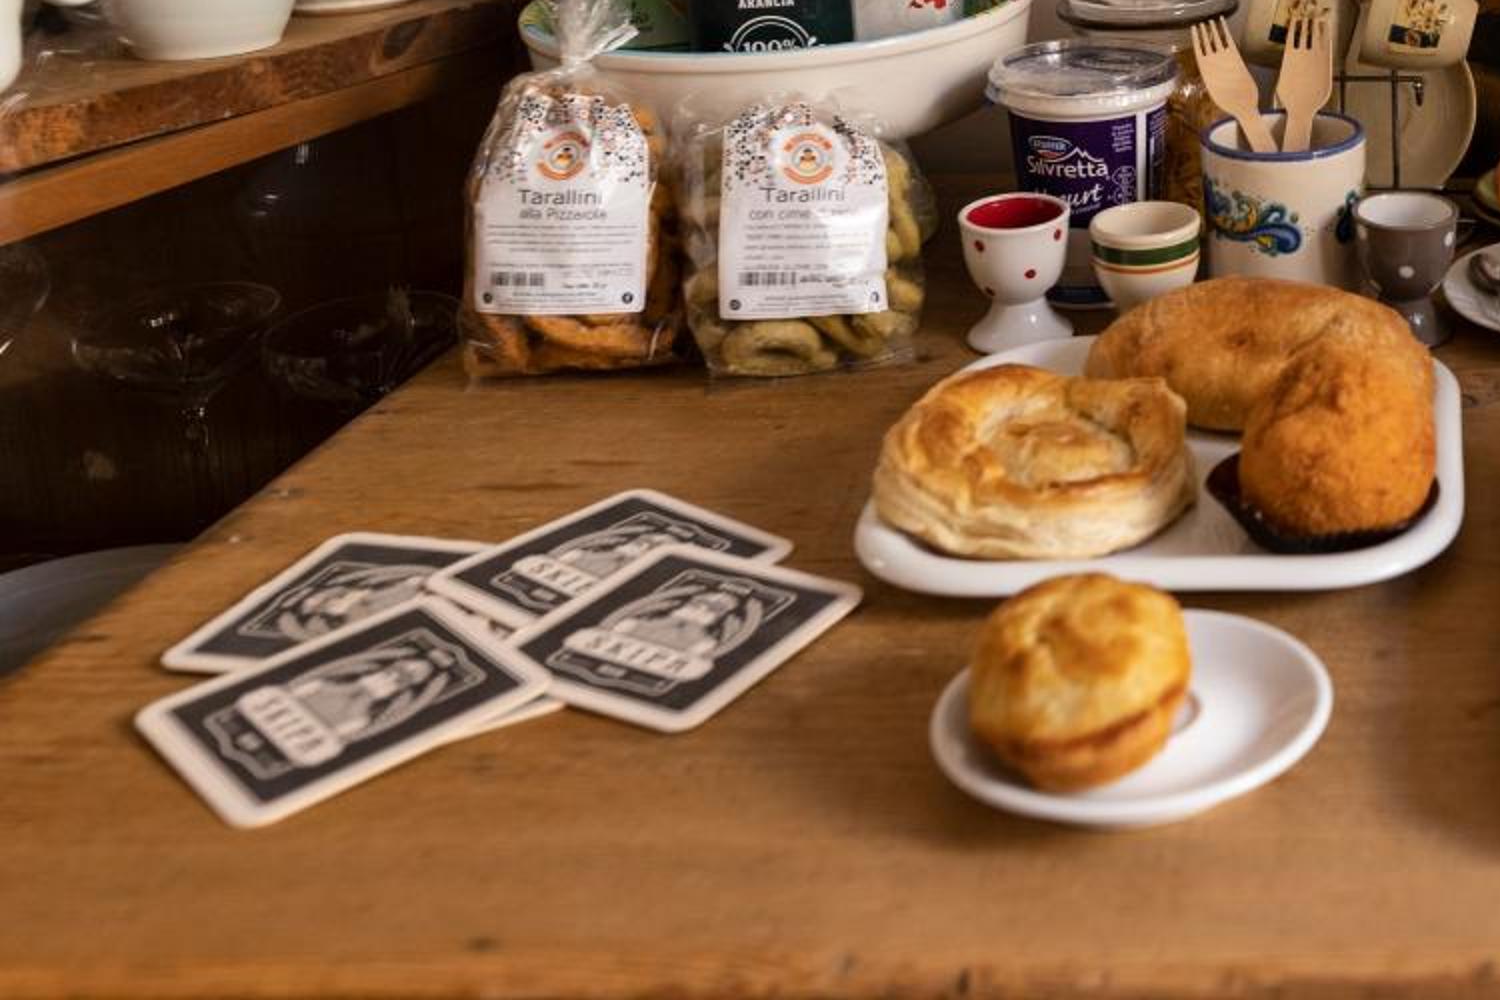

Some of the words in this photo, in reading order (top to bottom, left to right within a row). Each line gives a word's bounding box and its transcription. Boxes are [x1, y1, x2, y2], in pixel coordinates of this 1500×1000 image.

[1027, 155, 1109, 178] Silvretta
[517, 189, 603, 205] Tarallini
[758, 186, 845, 203] Tarallini
